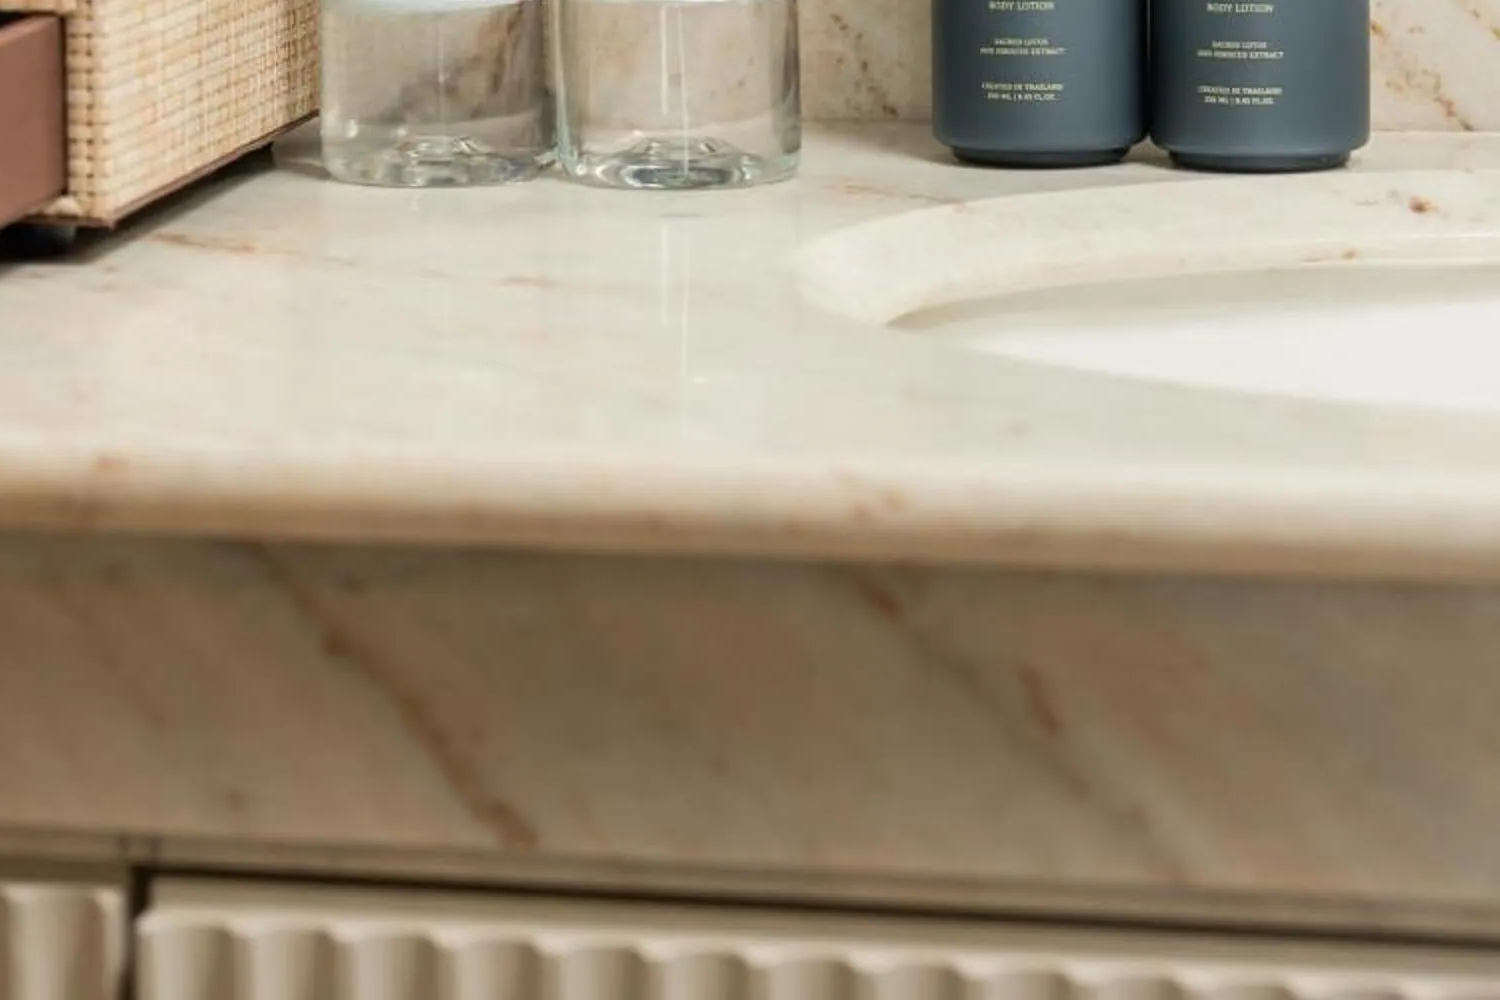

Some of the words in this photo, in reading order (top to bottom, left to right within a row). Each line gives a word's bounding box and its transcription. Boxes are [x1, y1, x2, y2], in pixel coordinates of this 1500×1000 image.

[988, 0, 1014, 11] BODY
[1017, 0, 1055, 11] LOTION
[1206, 2, 1233, 13] BODY
[1235, 3, 1274, 13] LOTION
